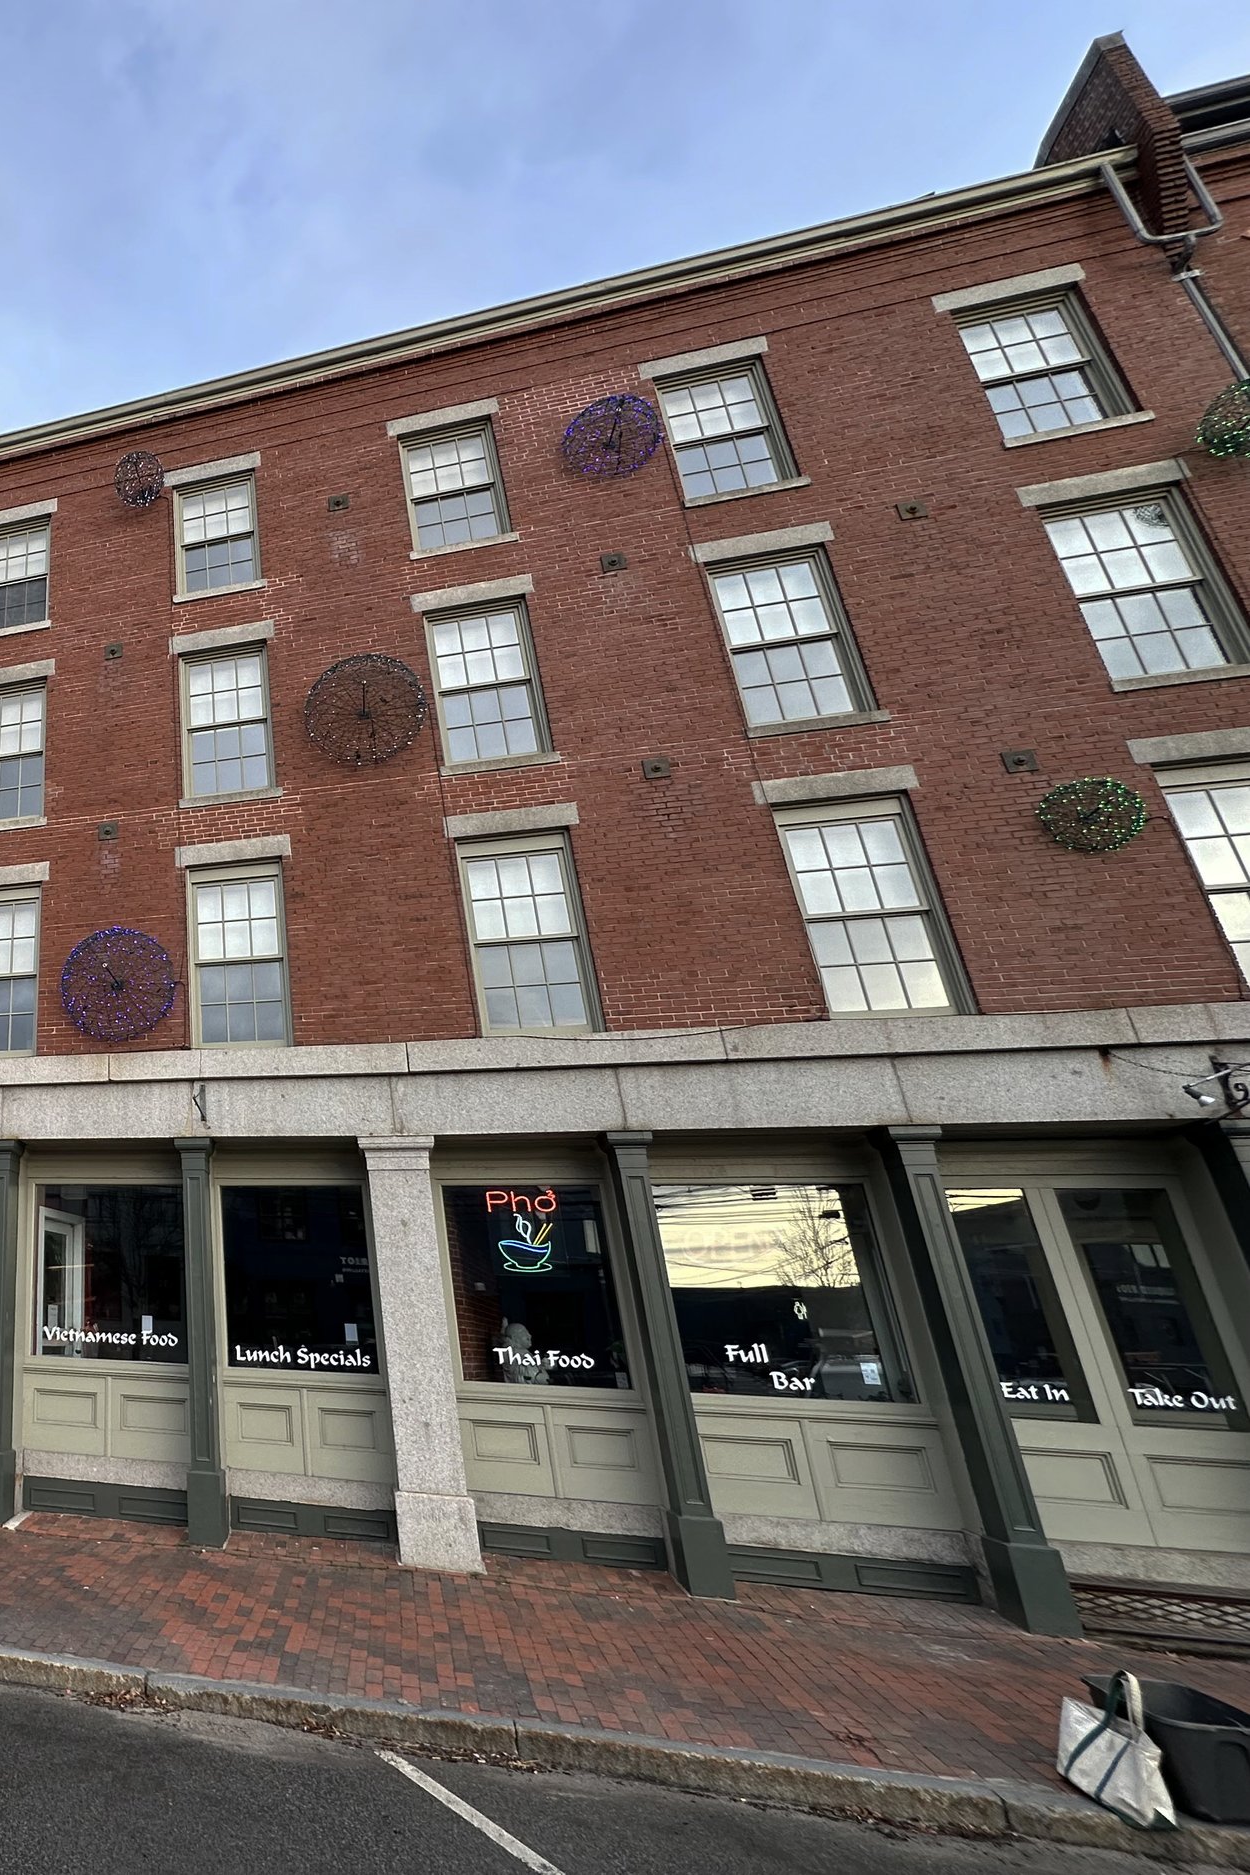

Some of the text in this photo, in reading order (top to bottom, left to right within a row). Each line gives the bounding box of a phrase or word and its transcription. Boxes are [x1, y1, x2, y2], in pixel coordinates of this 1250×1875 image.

[43, 1325, 178, 1347] Vietnamese Food
[235, 1345, 372, 1370] Lunch Specials
[493, 1346, 595, 1370] Thai Food
[724, 1343, 770, 1364] Full
[769, 1371, 816, 1391] Bar
[1000, 1382, 1070, 1402] Eat In
[1128, 1387, 1239, 1411] Take Out
